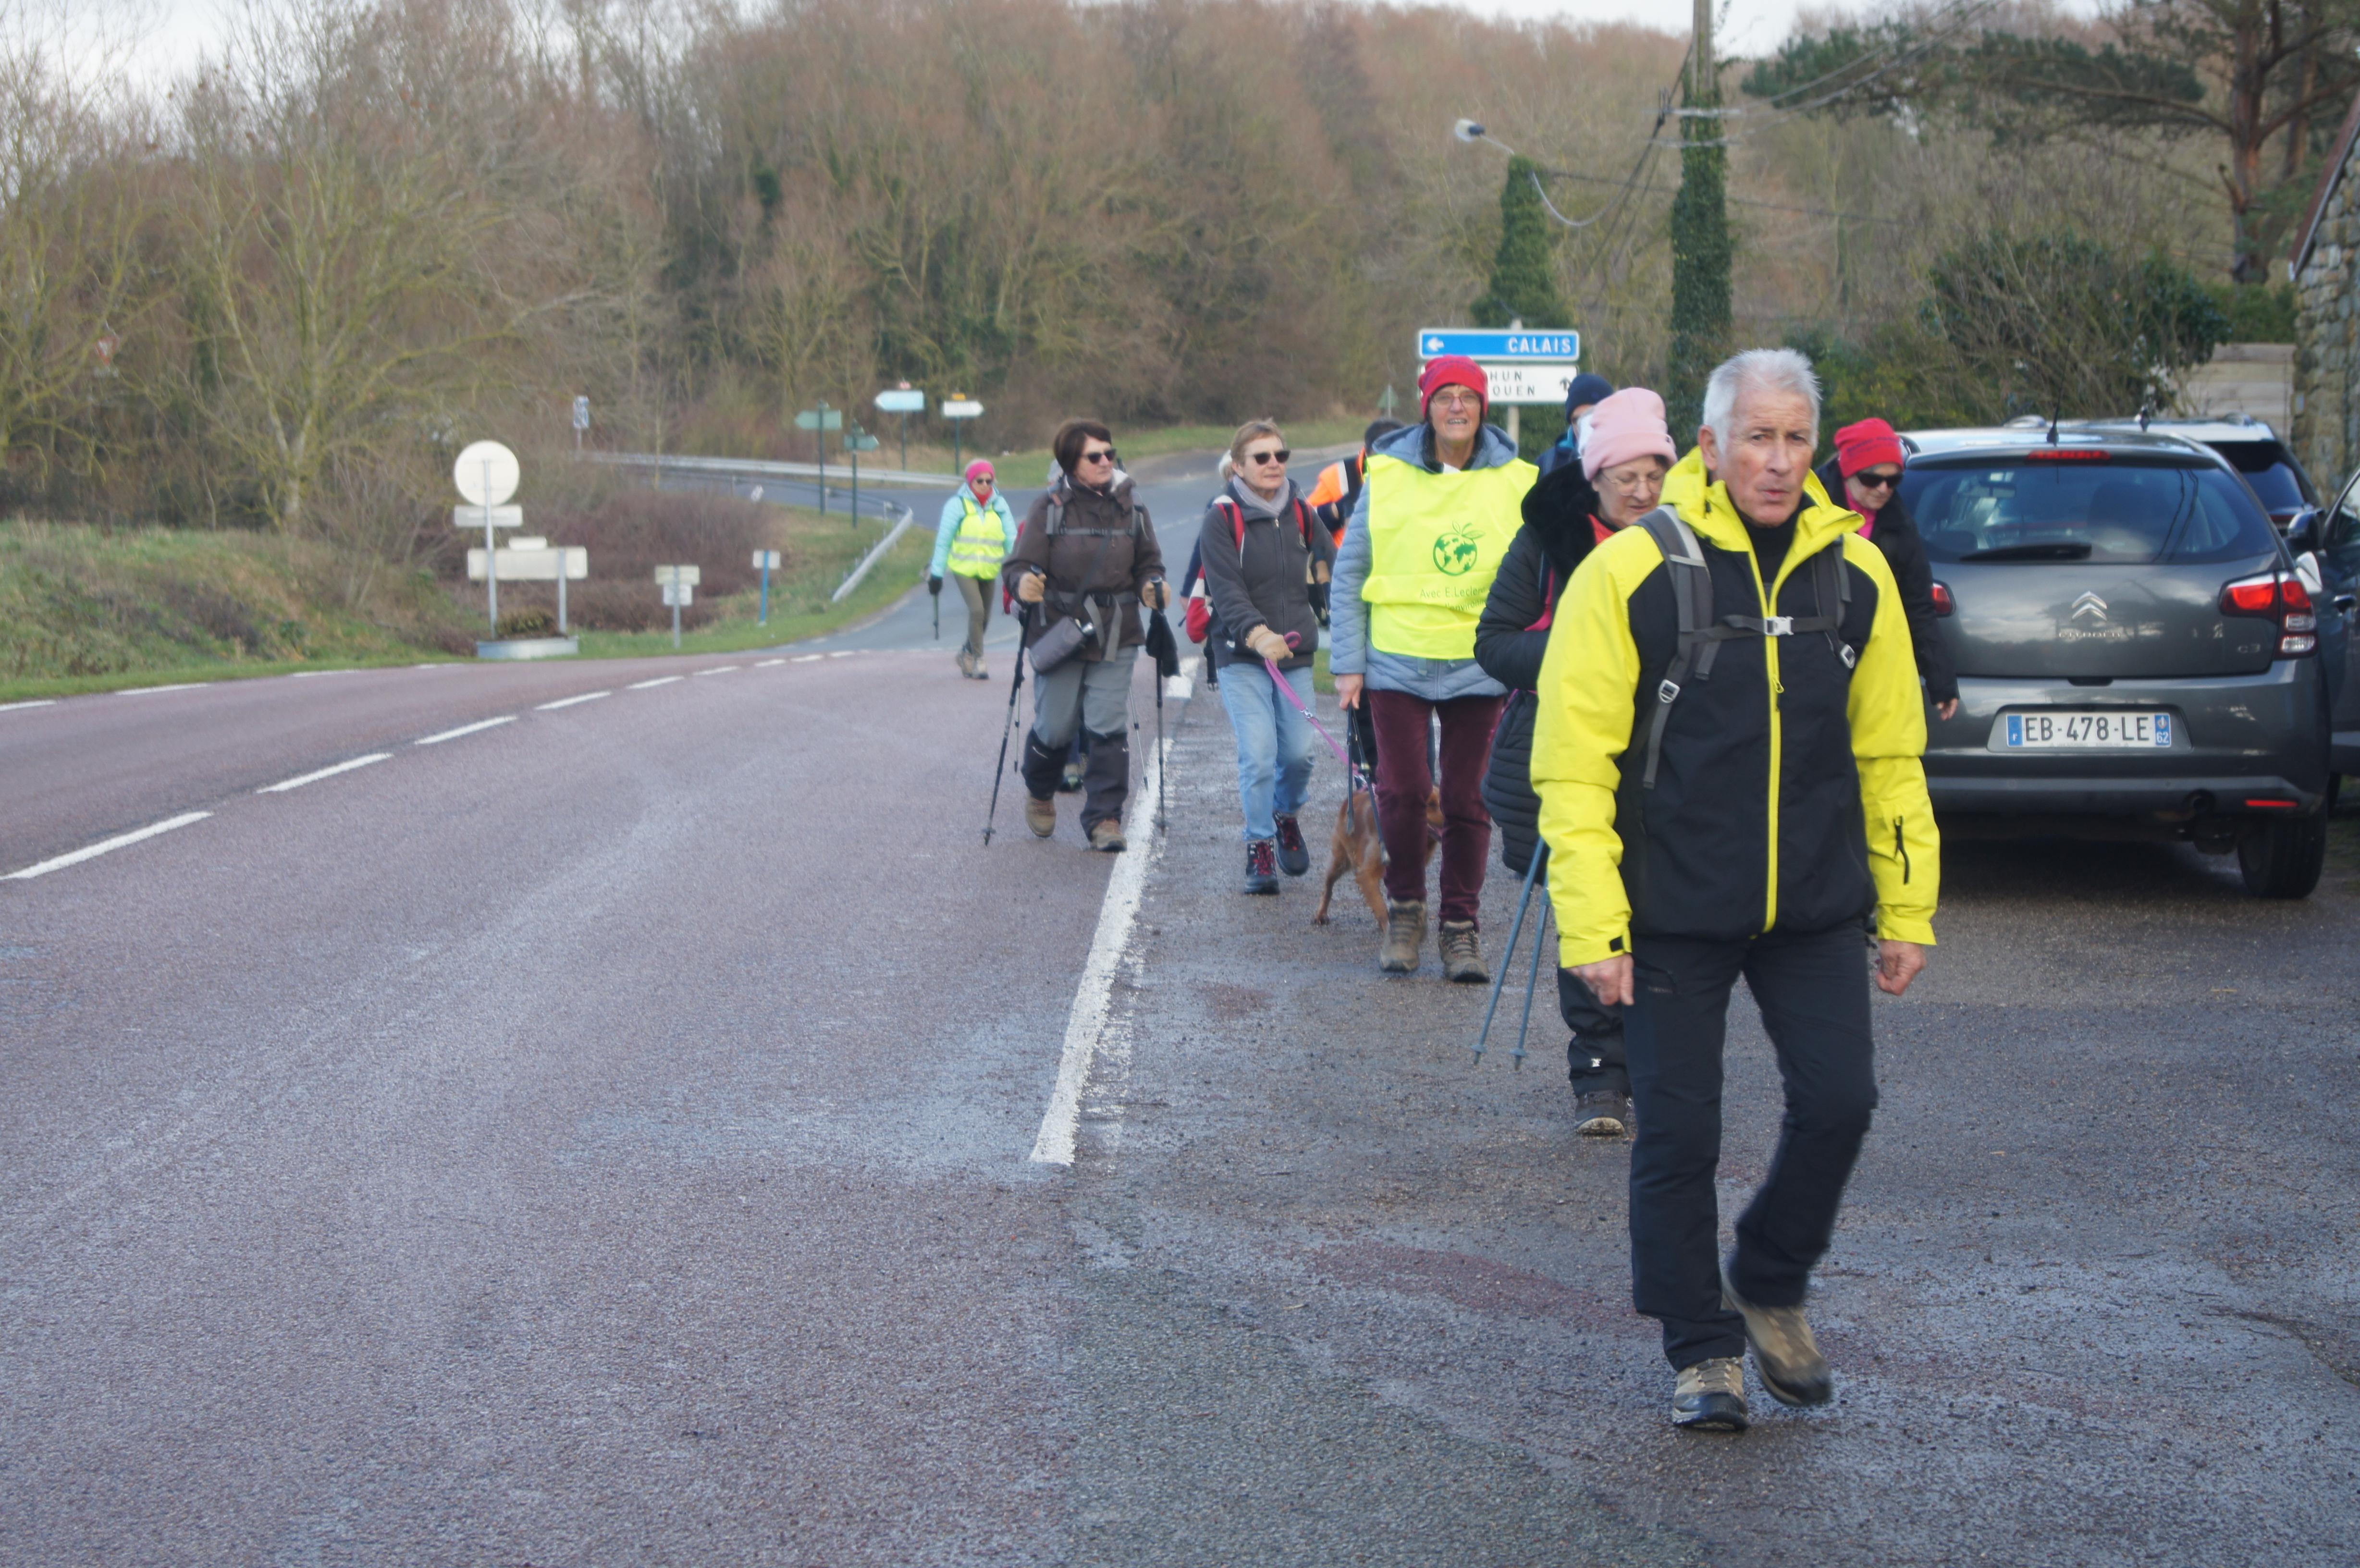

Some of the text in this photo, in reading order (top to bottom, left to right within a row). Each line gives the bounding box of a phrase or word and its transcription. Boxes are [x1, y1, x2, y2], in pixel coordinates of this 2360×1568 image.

[1508, 337, 1572, 353] CALAIS
[1420, 588, 1441, 599] Avec
[2237, 644, 2261, 654] C3
[2013, 717, 2169, 744] F EB-478-LE 62
